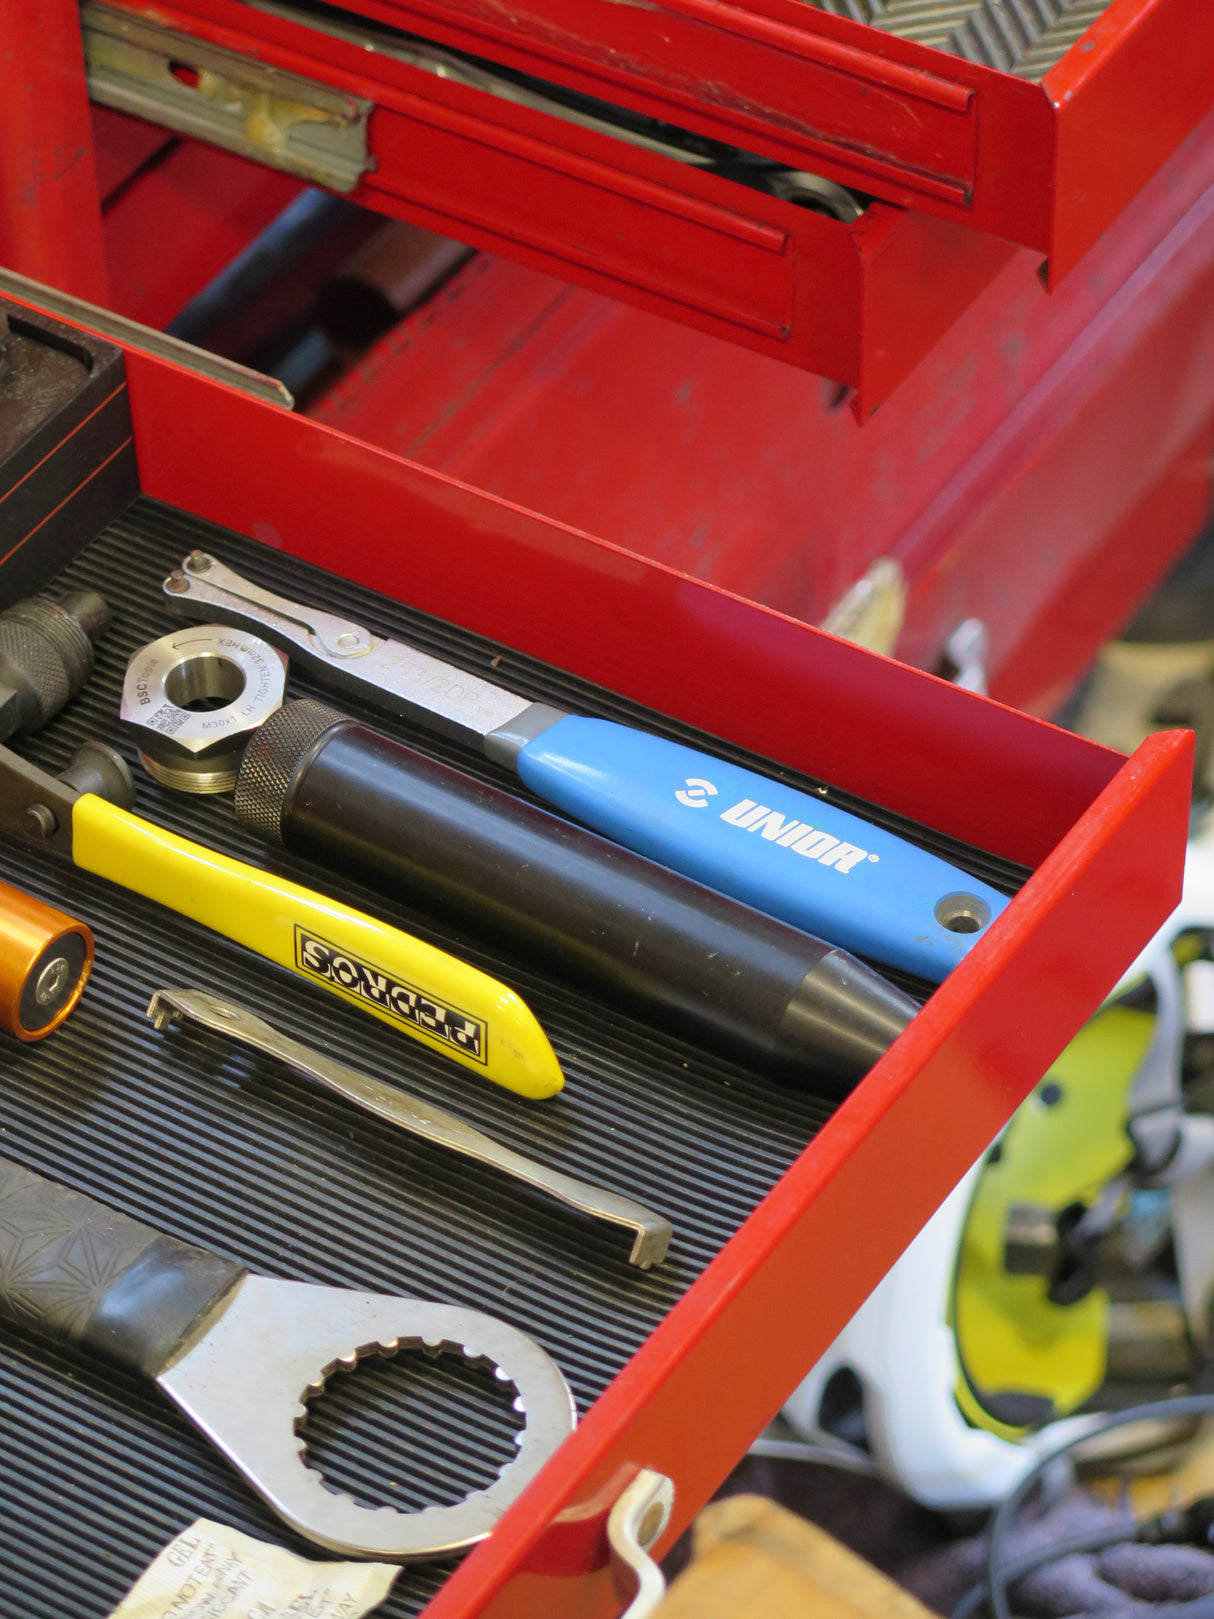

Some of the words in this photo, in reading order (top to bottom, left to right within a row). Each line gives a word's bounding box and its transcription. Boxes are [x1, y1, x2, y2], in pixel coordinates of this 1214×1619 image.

[201, 715, 238, 730] M30x1
[240, 705, 256, 717] LH
[252, 665, 271, 703] TIGHTEN
[719, 798, 869, 874] UNIOR
[166, 1537, 201, 1567] GEL
[171, 1574, 203, 1610] NOT
